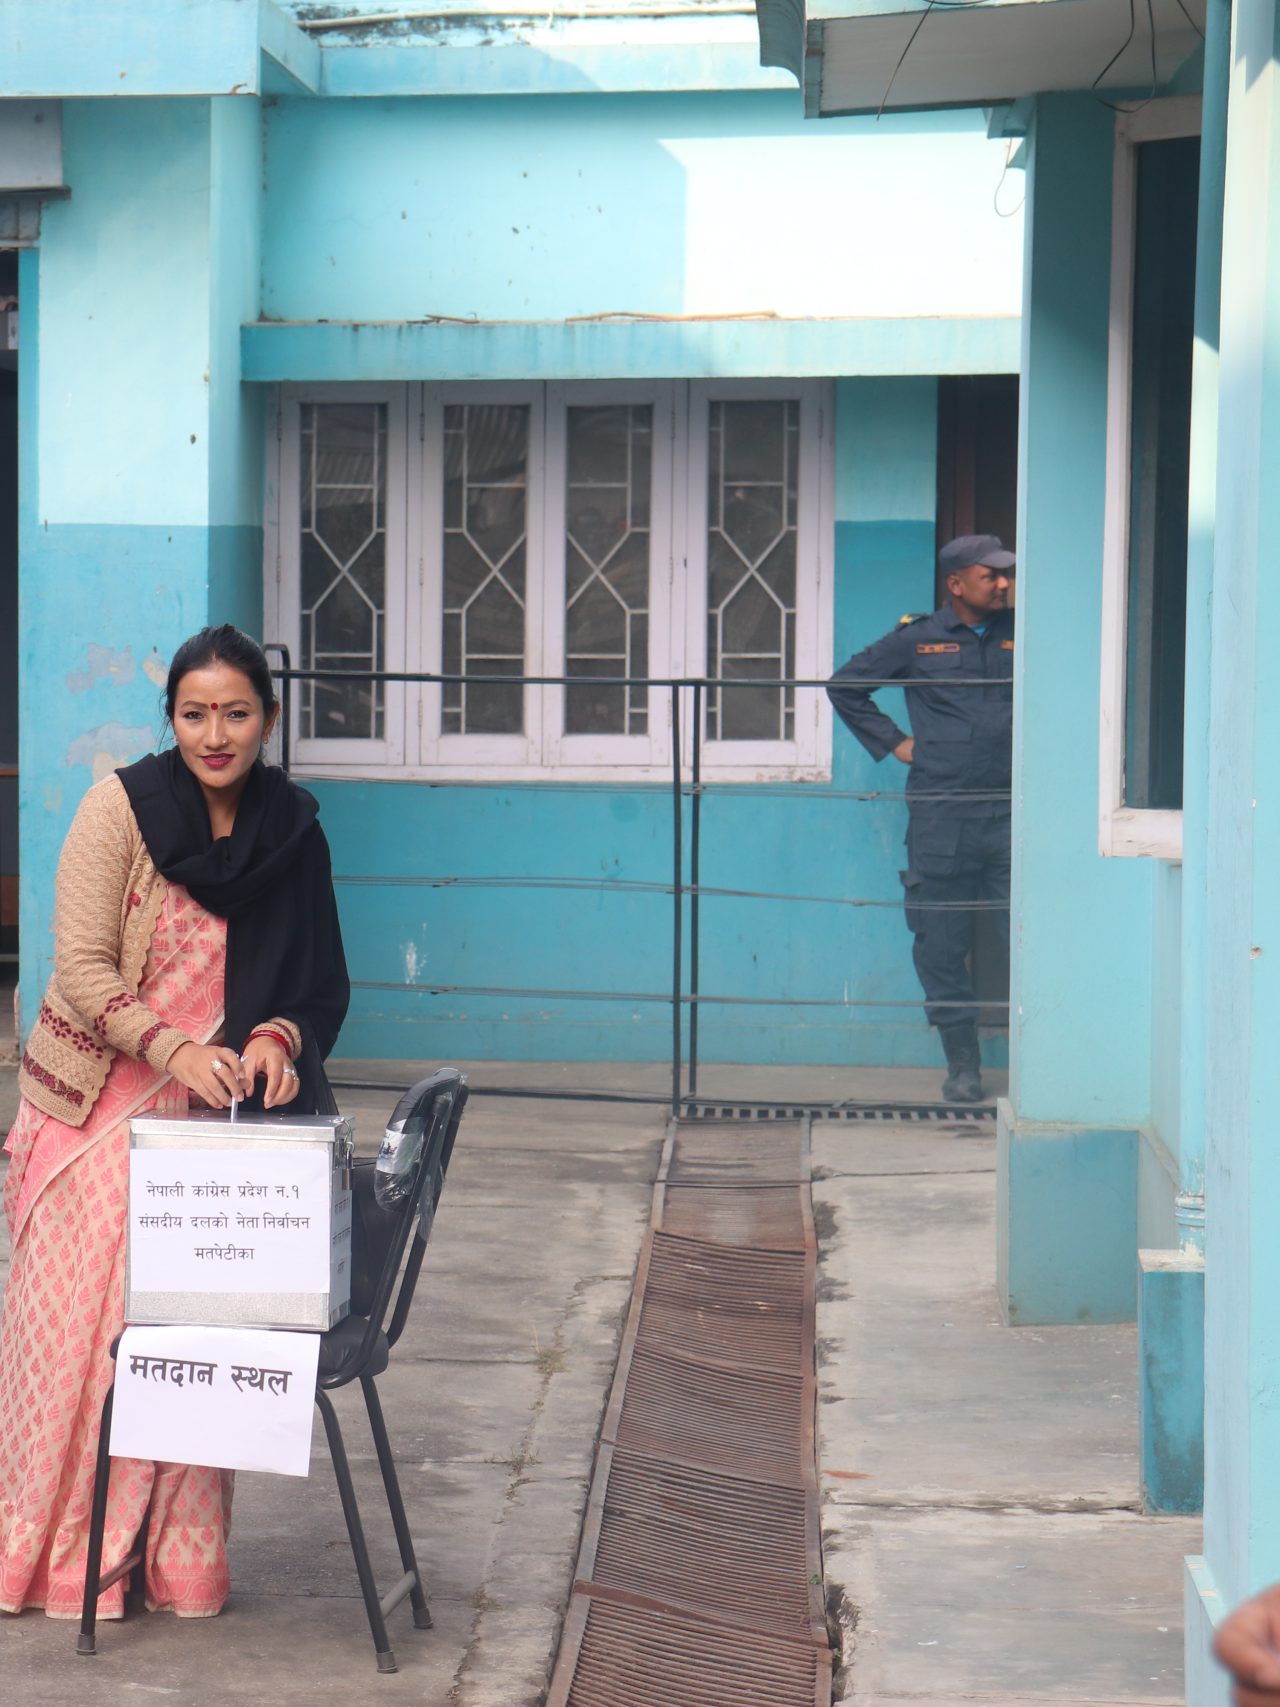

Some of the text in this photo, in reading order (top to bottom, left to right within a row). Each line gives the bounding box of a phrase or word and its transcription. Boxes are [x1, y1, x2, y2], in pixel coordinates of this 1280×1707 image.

[146, 1180, 184, 1198] नेपाली
[191, 1180, 231, 1198] कांग्रेस
[237, 1181, 268, 1198] प्रदेश
[138, 1212, 311, 1229] संसदीय दलको नेता निर्वाचन
[193, 1243, 256, 1260] मतपेटीका
[130, 1354, 293, 1396] मतदान स्थल
